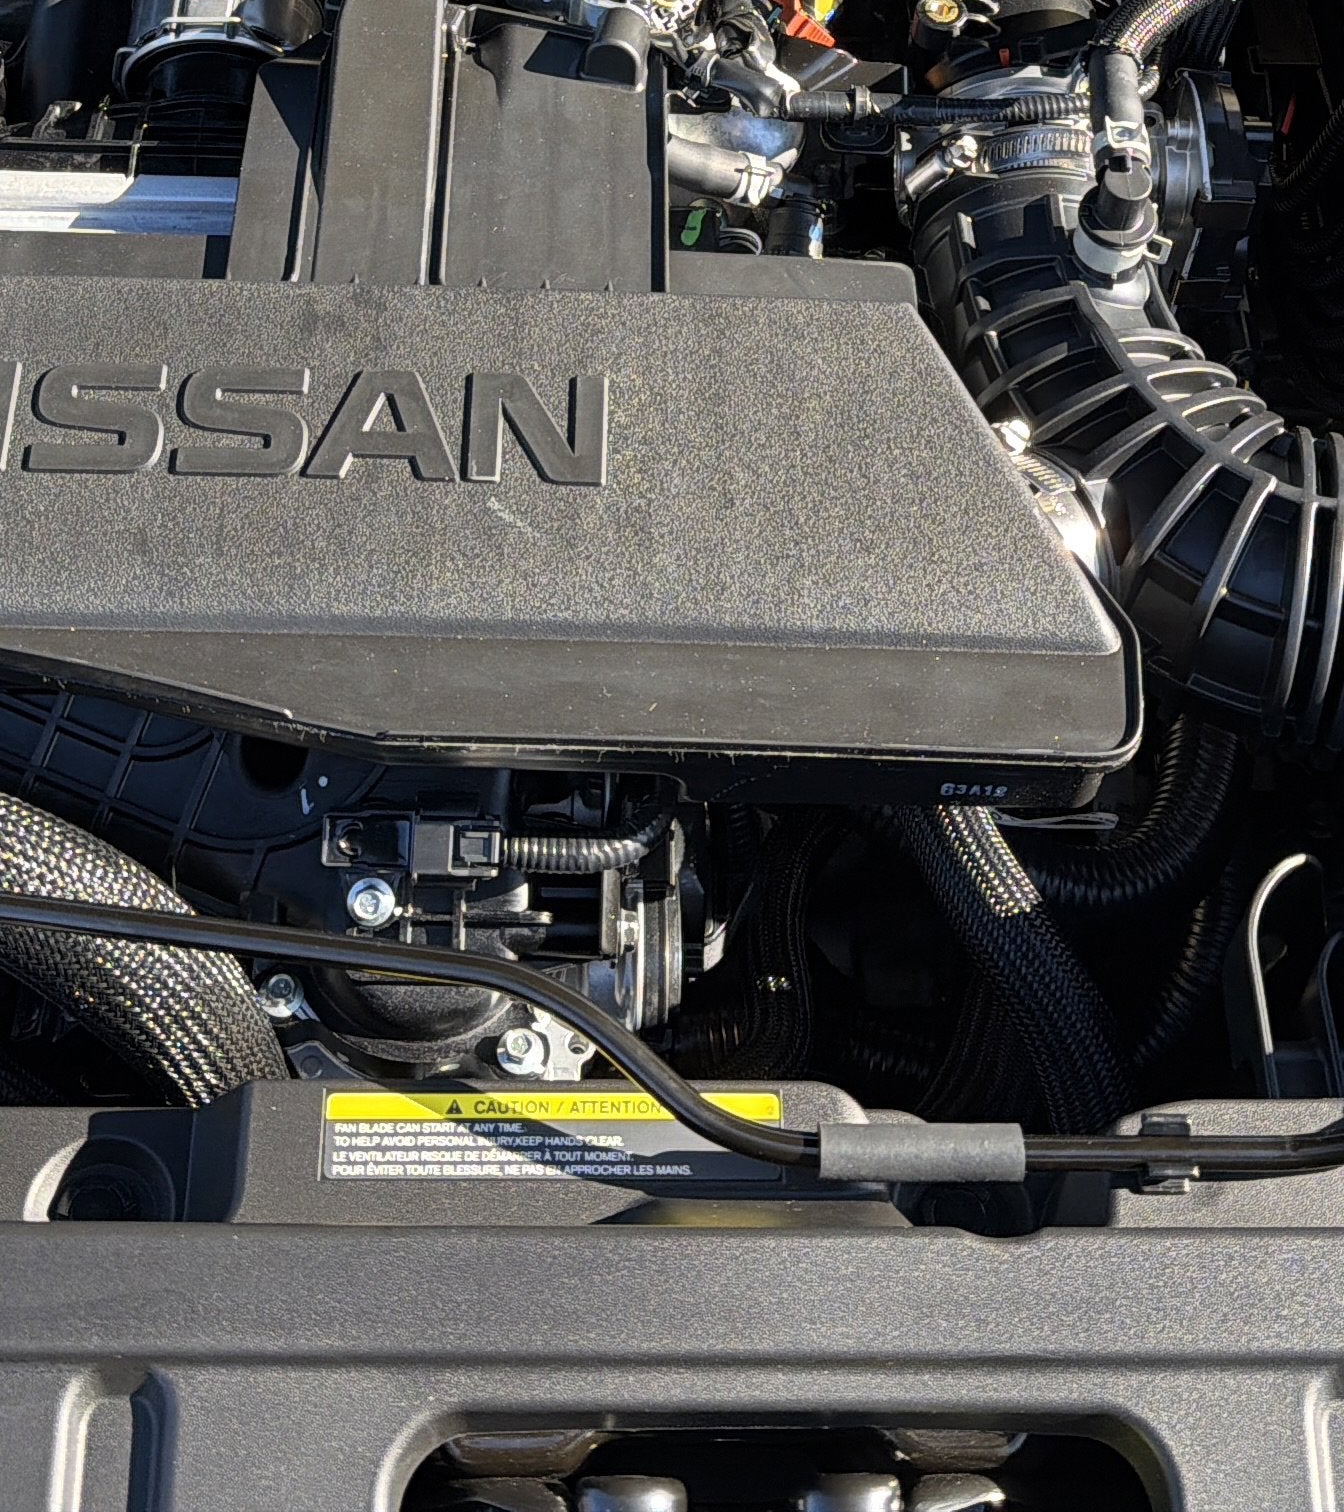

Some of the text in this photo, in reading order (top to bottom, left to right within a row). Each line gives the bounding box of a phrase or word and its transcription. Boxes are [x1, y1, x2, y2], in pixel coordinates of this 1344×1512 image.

[474, 1101, 549, 1115] CAUTION
[570, 1101, 661, 1114] ATTENTION
[334, 1123, 524, 1133] FAN BLADE CAN START AT ANY TIME.
[334, 1136, 349, 1147] TO
[352, 1136, 380, 1147] HELP
[382, 1136, 415, 1147] AVOID
[417, 1136, 476, 1147] PERSONAL
[545, 1136, 583, 1147] HANDS
[586, 1136, 624, 1147] CLEAR.
[332, 1148, 634, 1161] LE VENTILATEUR RISQUE DE DÉMARRER À TOUT MOMENT.
[332, 1165, 364, 1176] POUR
[366, 1162, 404, 1176] ÉVITER
[406, 1165, 441, 1176] TOUTE
[443, 1165, 502, 1177] BLESSURE,
[504, 1165, 520, 1176] NE
[522, 1165, 544, 1176] PAS
[565, 1165, 631, 1176] APPROCHER
[633, 1165, 654, 1176] LES
[656, 1165, 693, 1176] MAINS.
